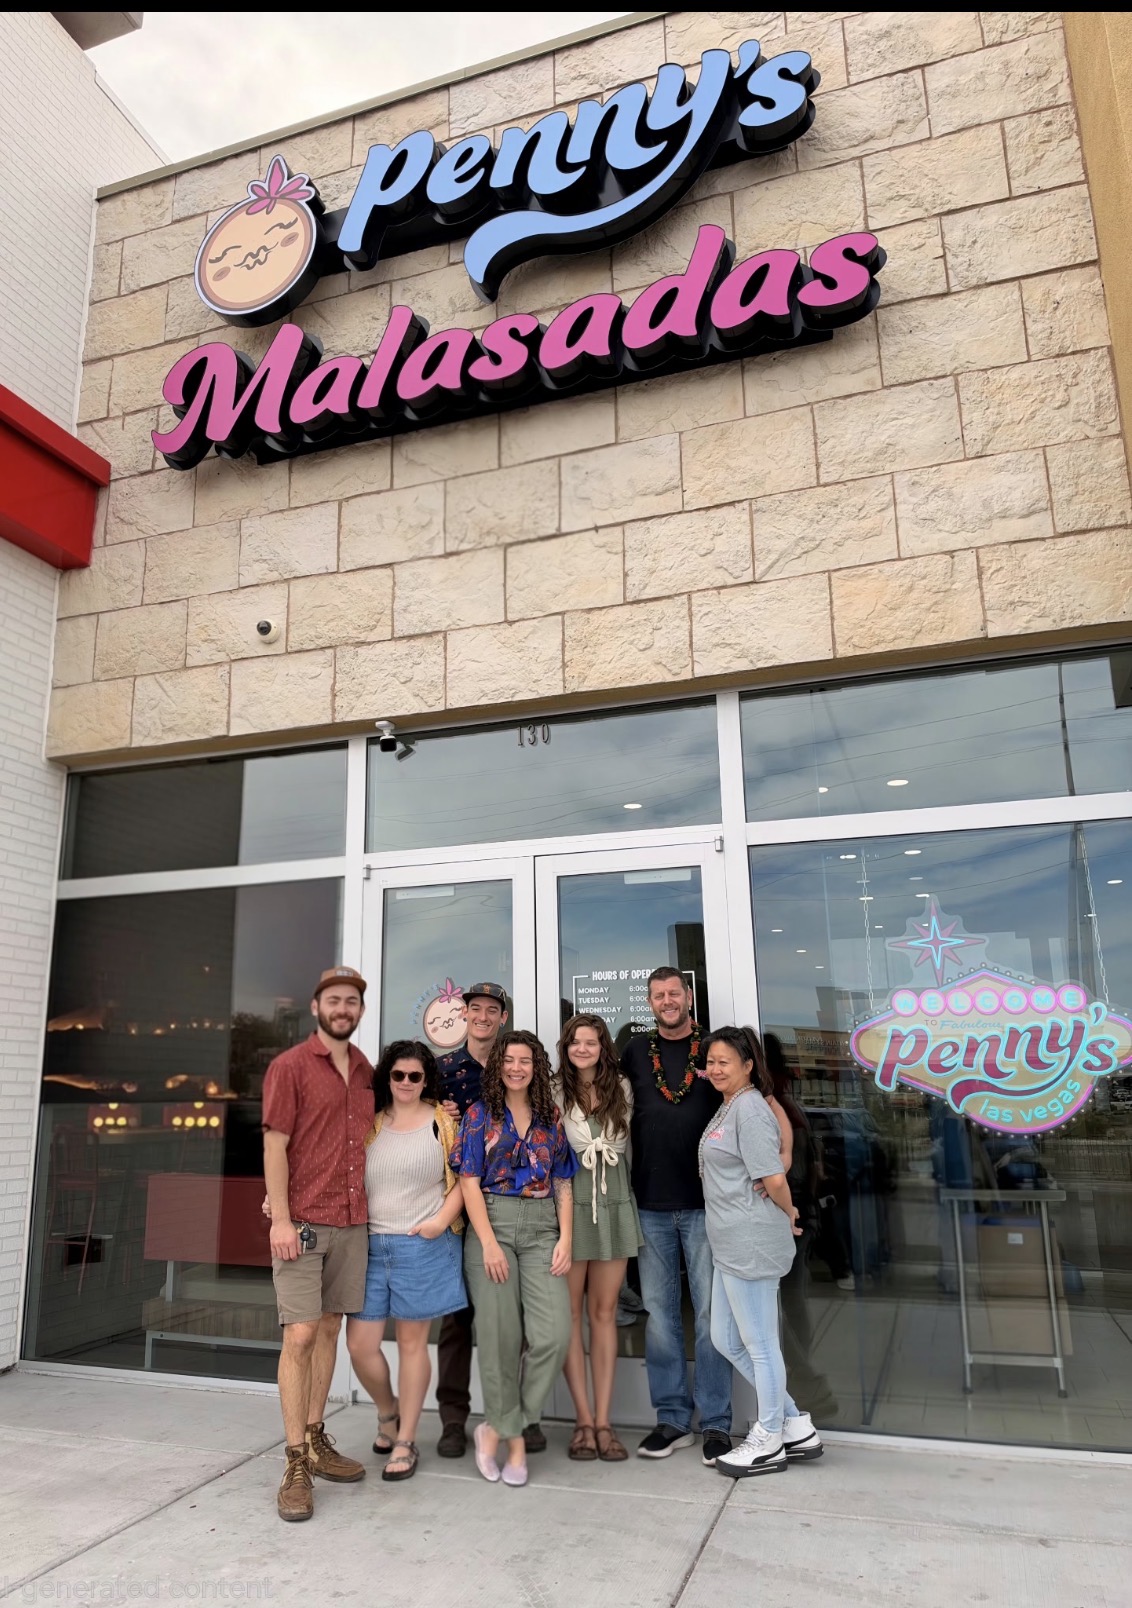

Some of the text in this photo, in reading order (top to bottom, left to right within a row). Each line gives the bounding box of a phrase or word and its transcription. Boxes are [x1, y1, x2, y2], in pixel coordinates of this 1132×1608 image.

[337, 39, 812, 284] penny's
[151, 224, 879, 456] Malasadas
[517, 723, 551, 748] 130
[592, 969, 656, 981] HOURS OF OPER
[579, 1006, 622, 1014] WEDNESDAY
[895, 989, 1080, 1011] WELCOME
[924, 1019, 938, 1027] TO
[875, 1002, 1119, 1114] penny's
[979, 1079, 1081, 1123] las vegas
